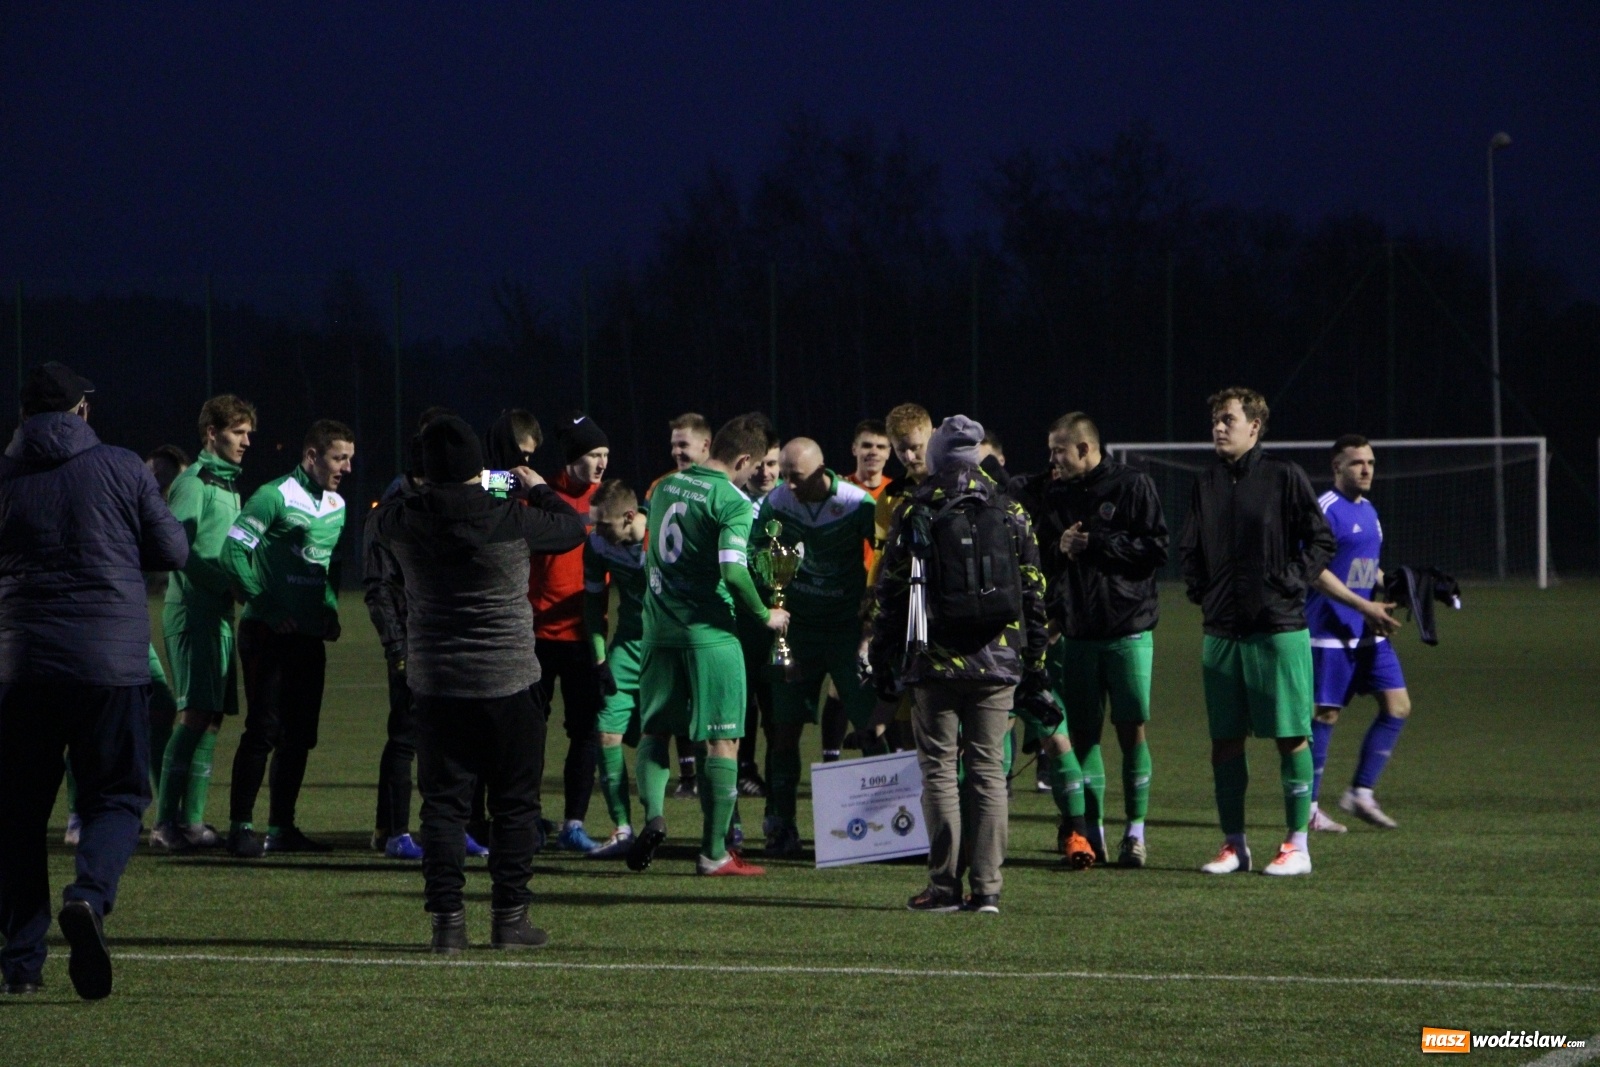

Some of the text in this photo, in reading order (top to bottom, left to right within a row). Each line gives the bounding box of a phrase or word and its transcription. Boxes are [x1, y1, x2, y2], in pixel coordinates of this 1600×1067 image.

[659, 501, 687, 563] 6
[861, 777, 866, 788] 2
[869, 775, 887, 786] 000
